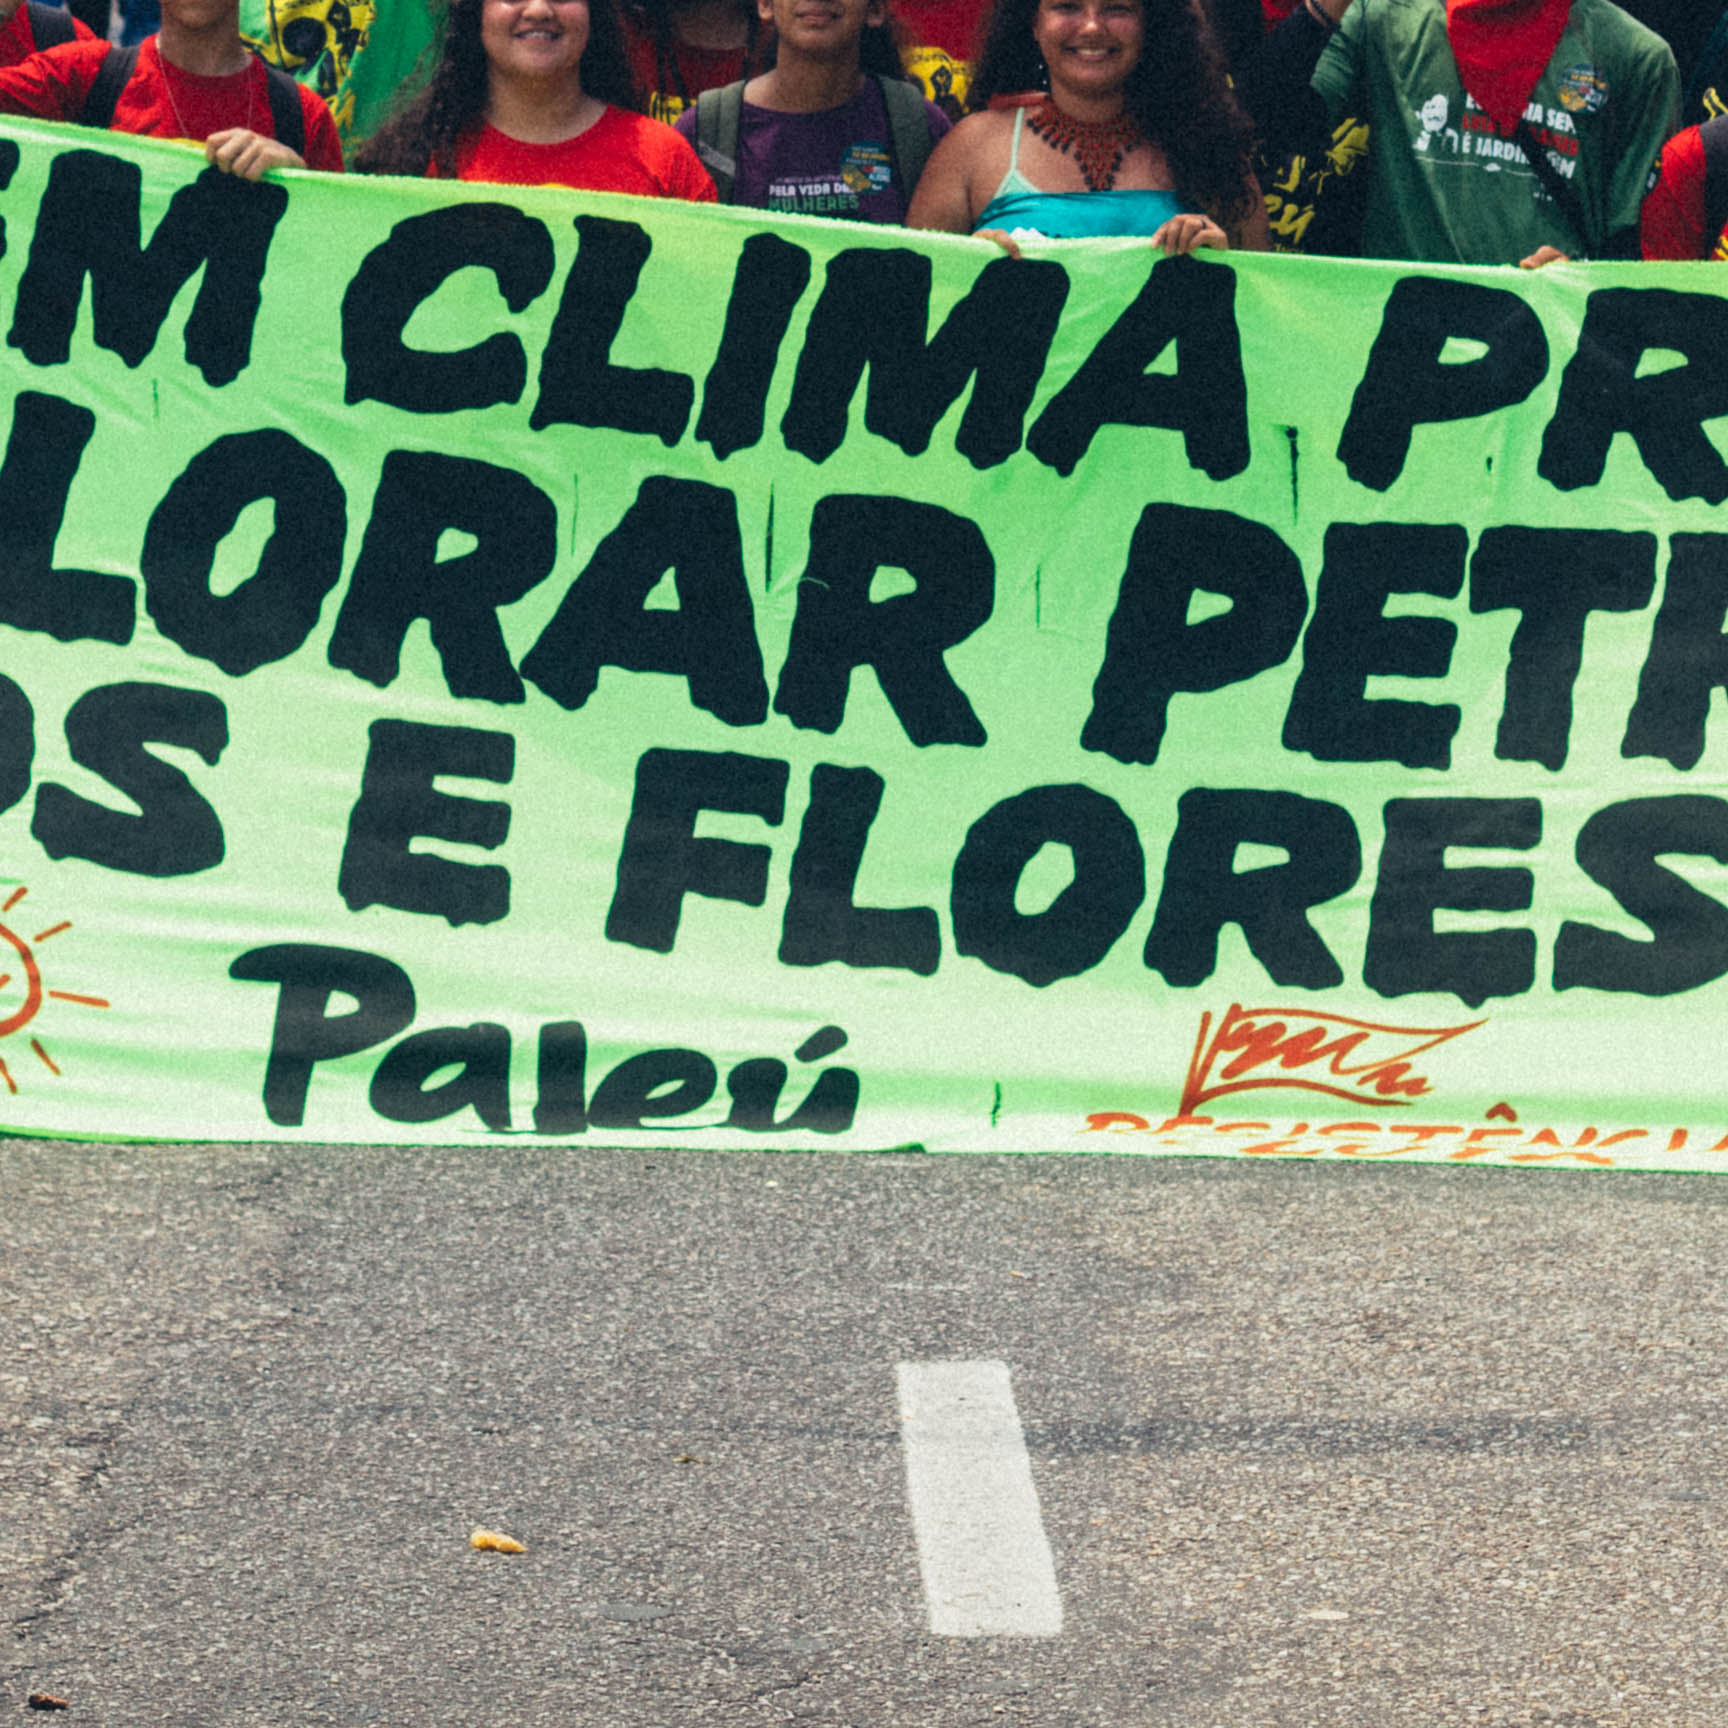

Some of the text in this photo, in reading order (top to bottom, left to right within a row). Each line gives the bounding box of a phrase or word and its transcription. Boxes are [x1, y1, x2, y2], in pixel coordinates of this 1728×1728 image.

[768, 194, 860, 212] MULHERES
[769, 184, 797, 197] PELA
[798, 183, 831, 196] VIDA
[341, 202, 1251, 479] CLIMA
[339, 719, 515, 927] E
